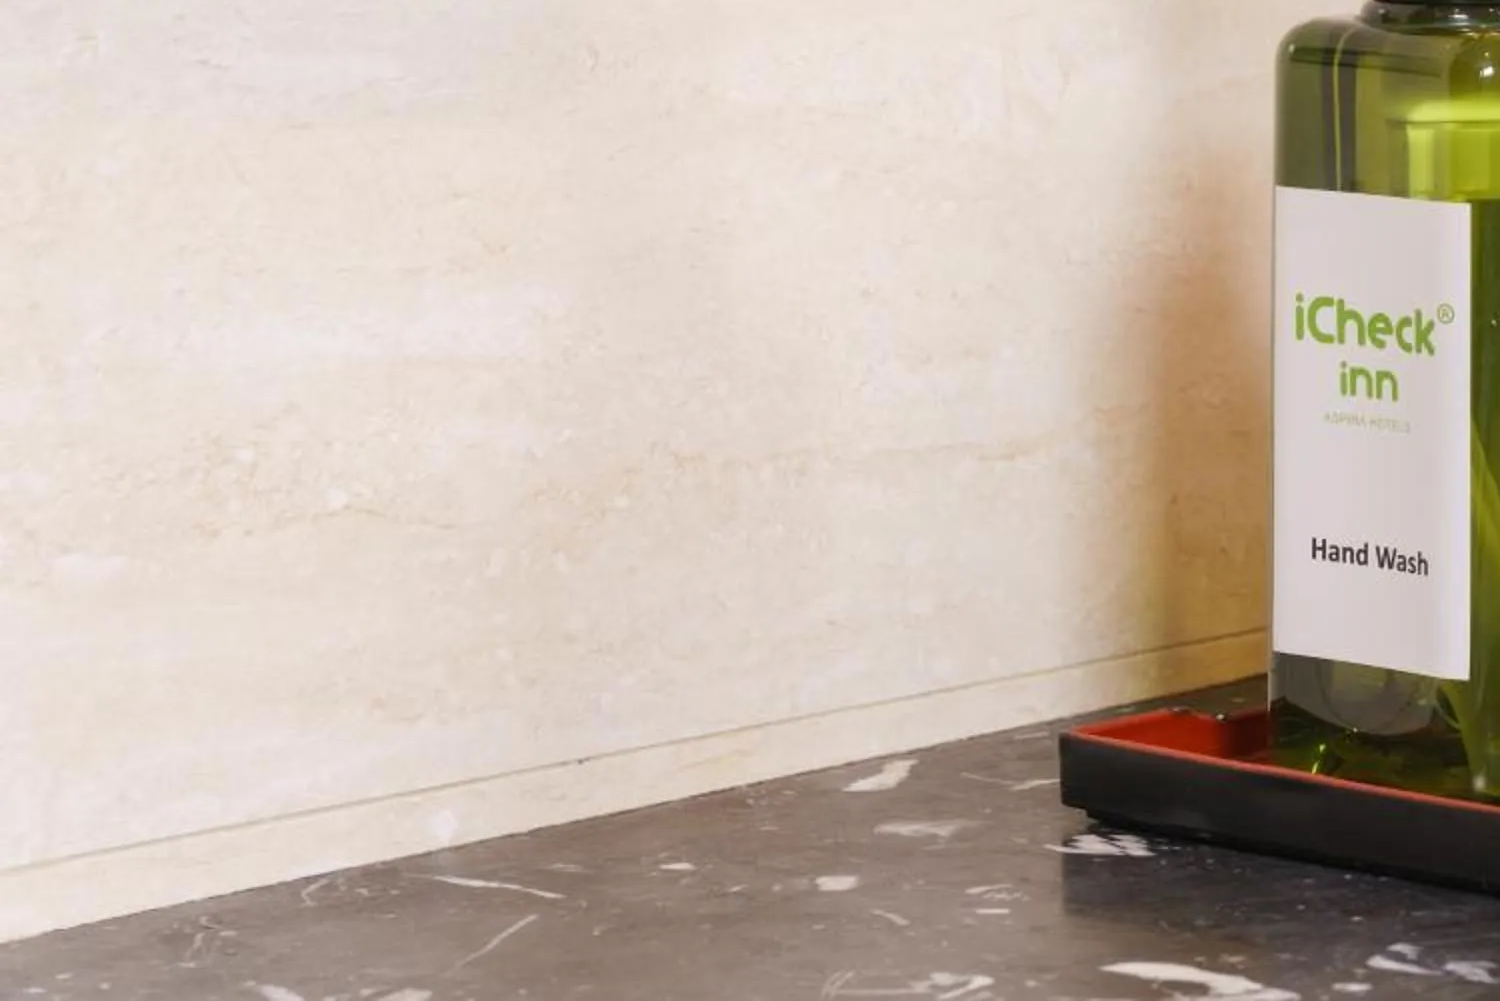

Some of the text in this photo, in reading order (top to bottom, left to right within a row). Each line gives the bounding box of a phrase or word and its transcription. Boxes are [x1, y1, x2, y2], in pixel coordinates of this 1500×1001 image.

[1339, 360, 1399, 402] inn
[1311, 537, 1429, 576] Hand Wash
